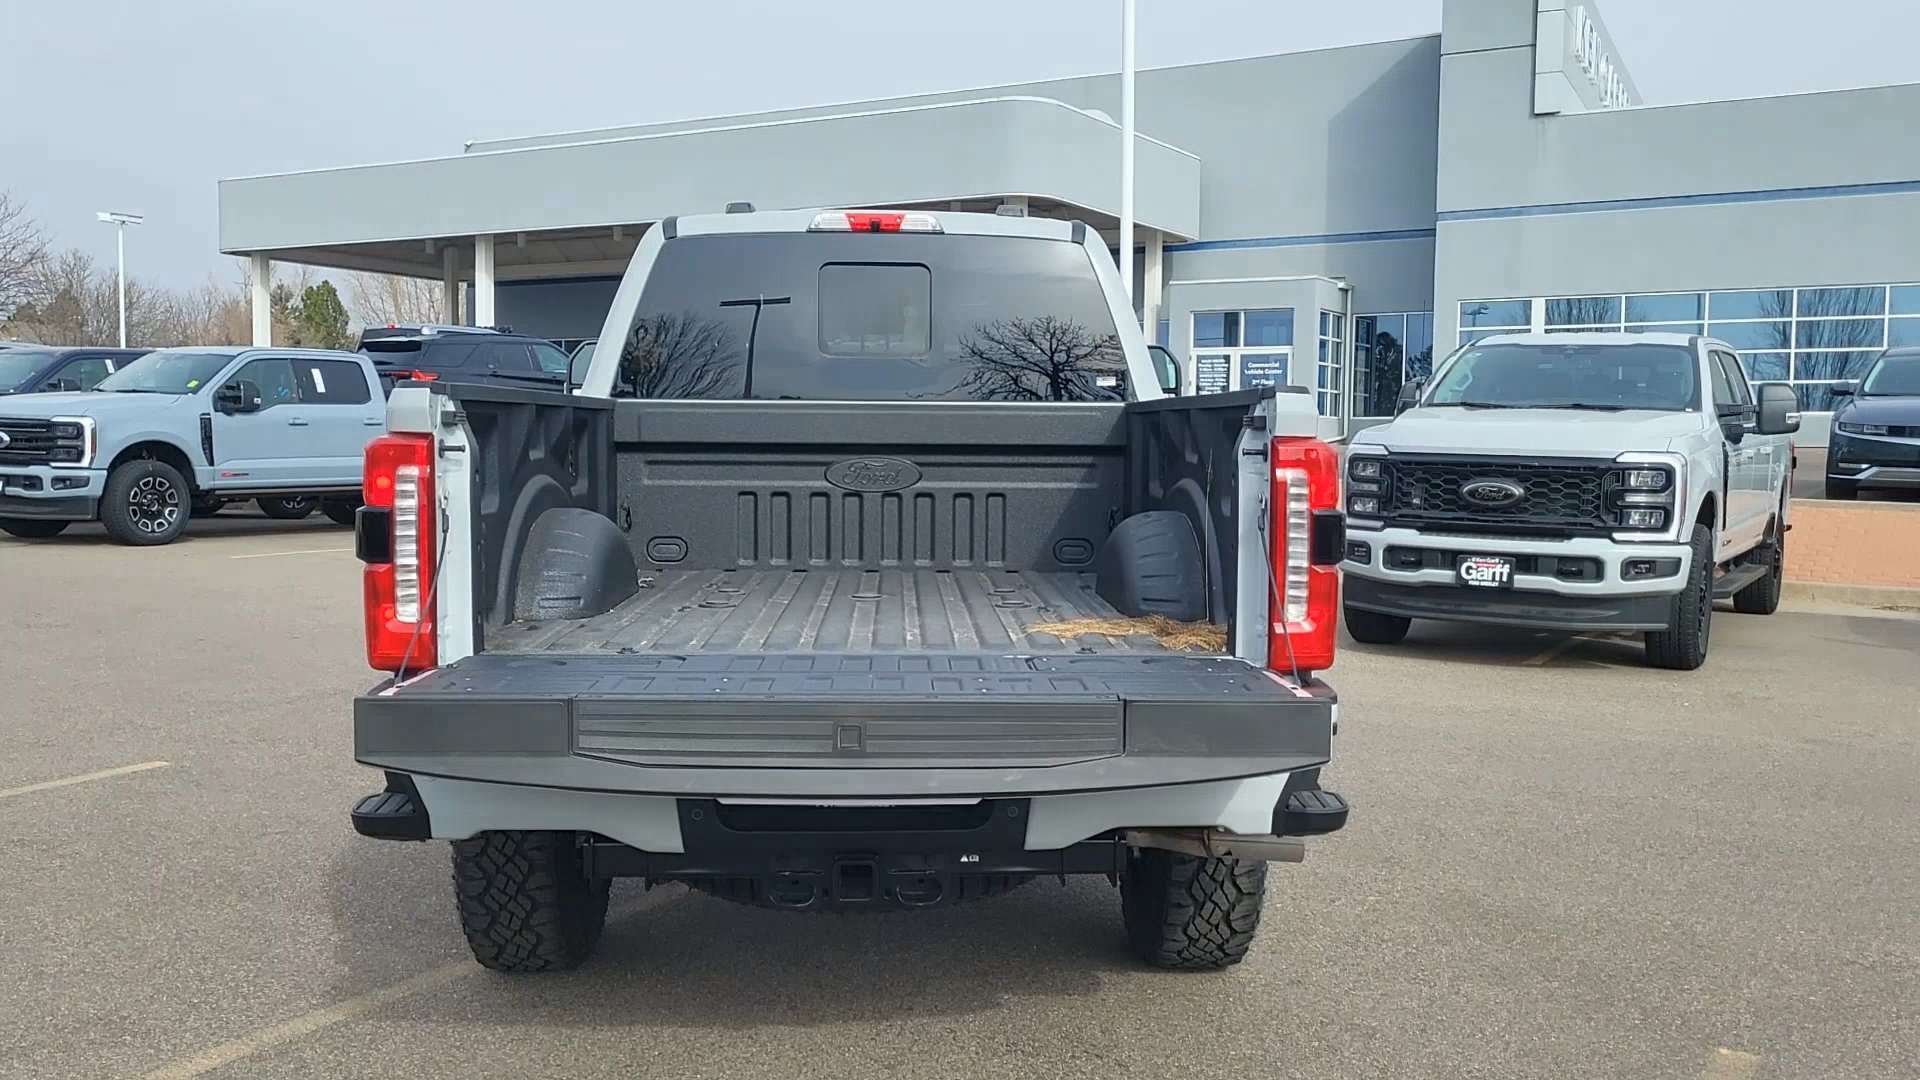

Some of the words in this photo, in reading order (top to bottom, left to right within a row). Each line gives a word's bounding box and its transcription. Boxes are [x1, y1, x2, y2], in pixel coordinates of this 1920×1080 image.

[842, 460, 902, 485] Ford
[1475, 486, 1506, 500] Ford
[1460, 562, 1510, 582] Garff
